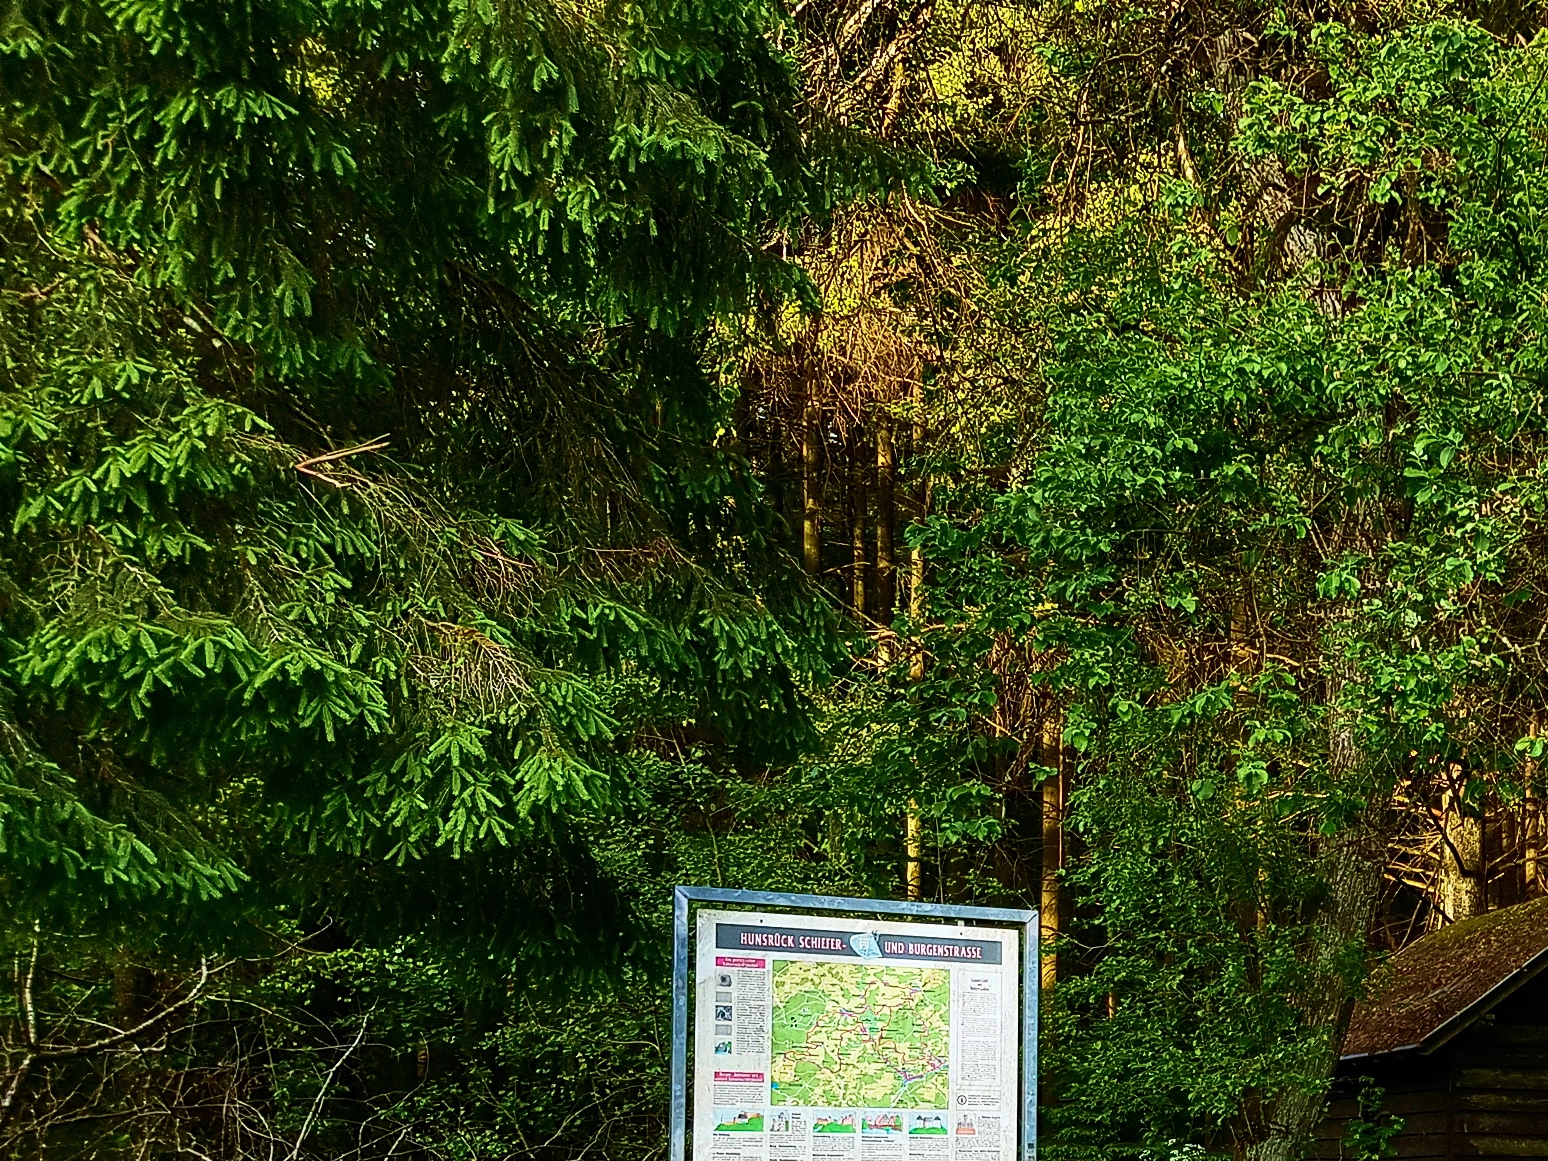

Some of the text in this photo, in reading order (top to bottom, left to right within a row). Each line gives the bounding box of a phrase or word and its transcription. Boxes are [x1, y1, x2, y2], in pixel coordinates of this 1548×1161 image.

[740, 932, 983, 959] HUNSRÜCK SCHIEFER- UND BURGENSTRASSE
